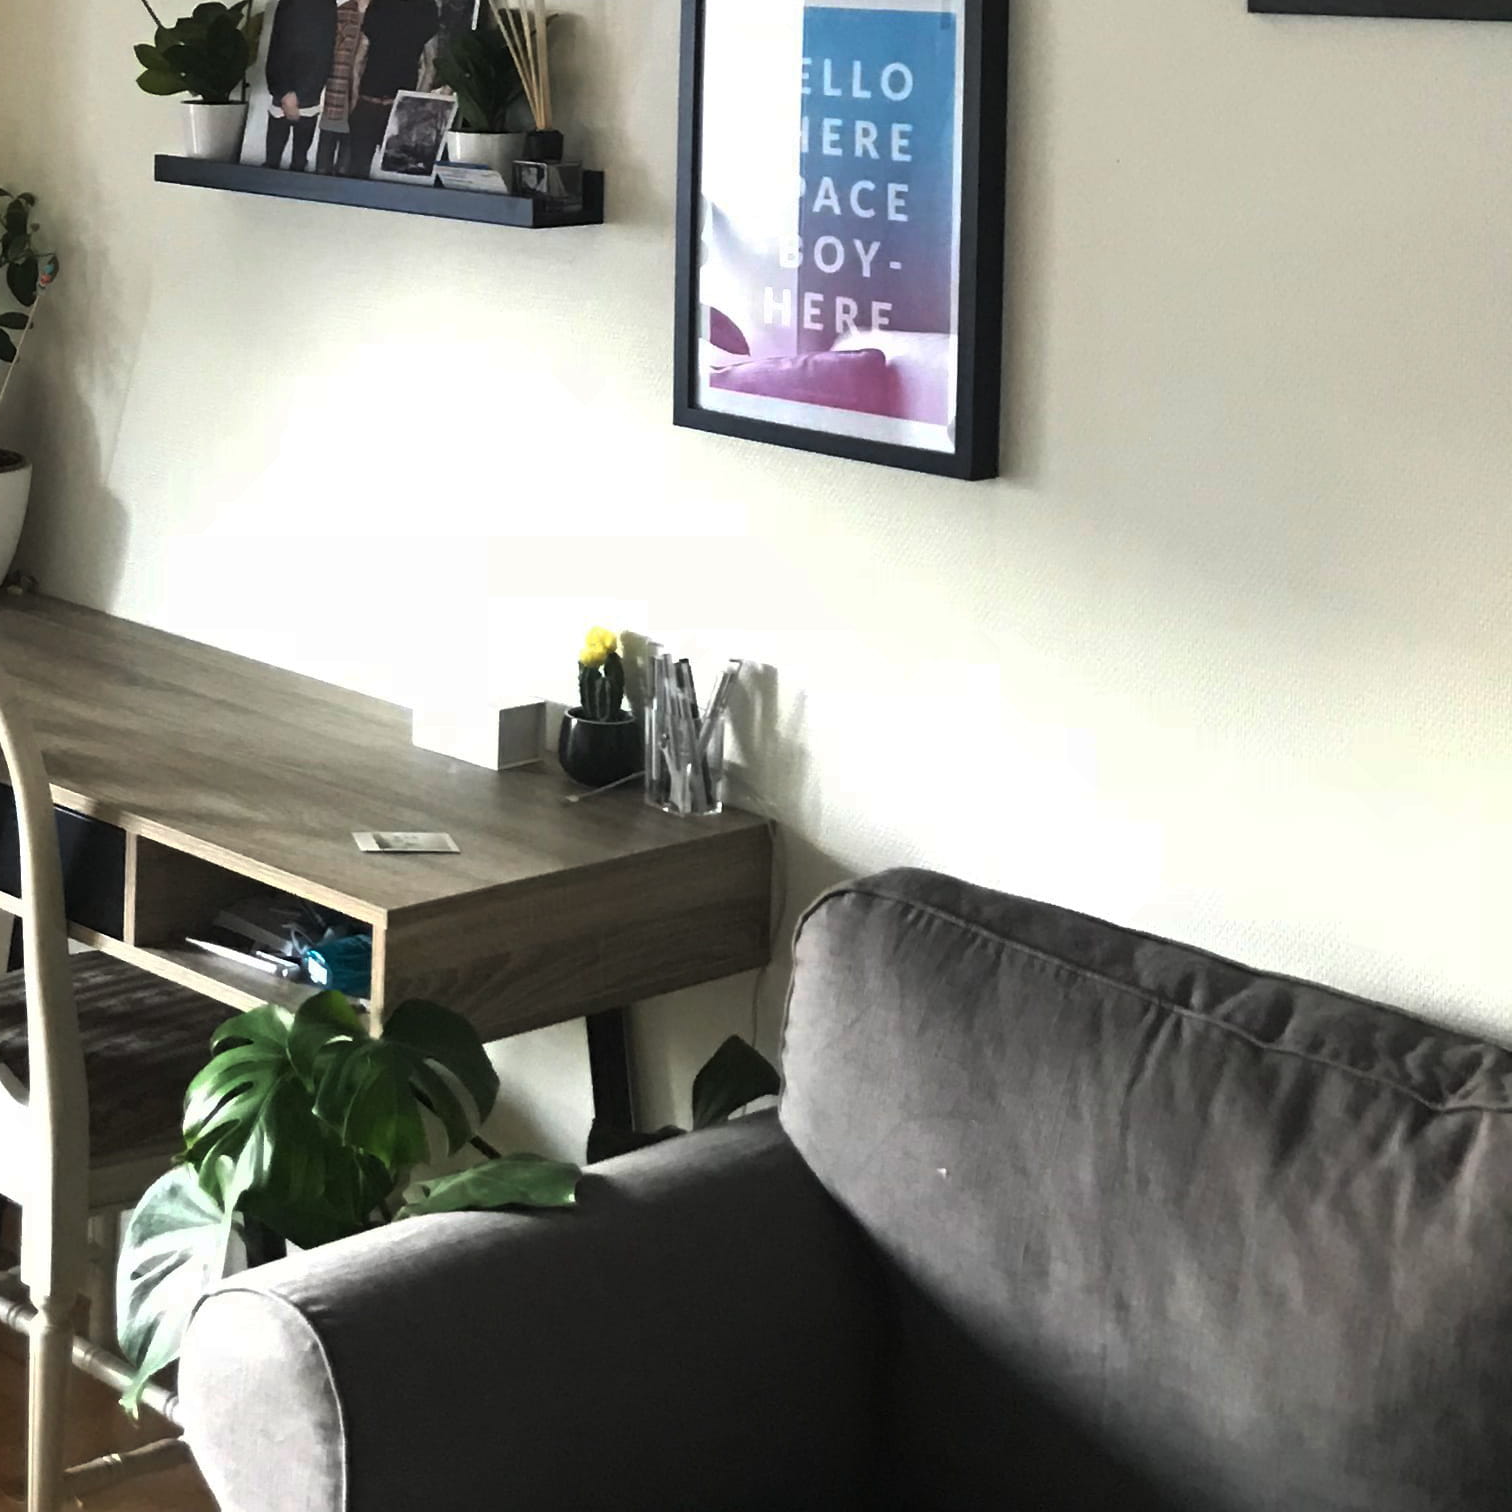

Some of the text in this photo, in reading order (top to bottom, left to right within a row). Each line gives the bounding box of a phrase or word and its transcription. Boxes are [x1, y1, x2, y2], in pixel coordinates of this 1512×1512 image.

[801, 57, 914, 102] ELLO
[801, 115, 914, 163] ERE
[800, 176, 909, 223] ACE
